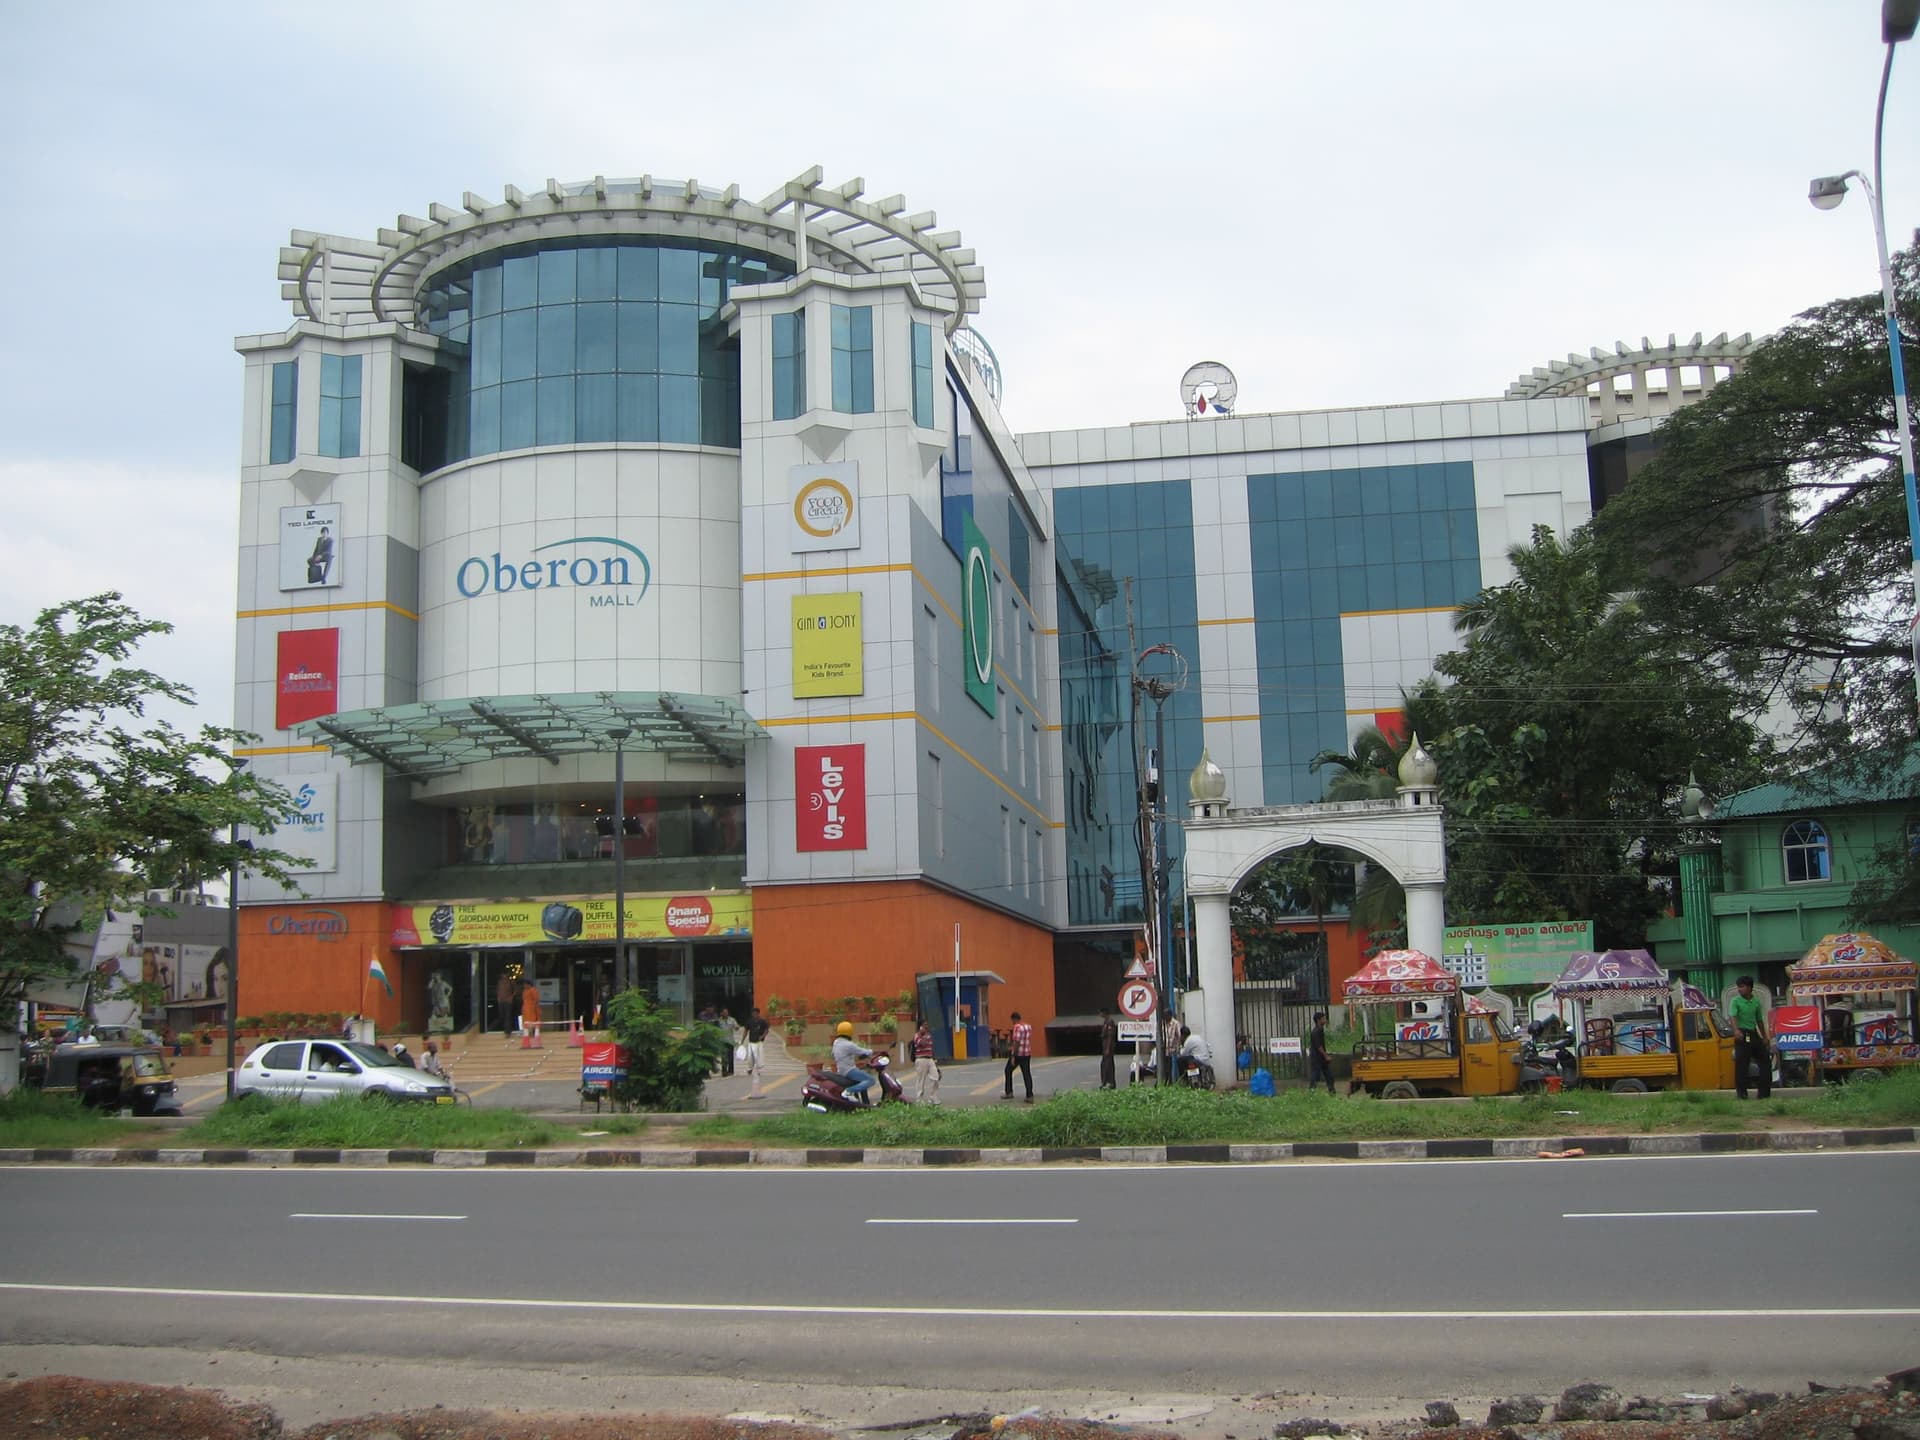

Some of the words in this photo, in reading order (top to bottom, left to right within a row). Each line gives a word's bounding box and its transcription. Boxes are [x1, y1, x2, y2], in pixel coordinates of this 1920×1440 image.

[808, 496, 843, 507] FOOD
[808, 506, 843, 517] CIRCLE
[457, 552, 632, 598] Oberon
[590, 595, 634, 607] MALL
[288, 672, 322, 680] Reliance
[458, 905, 476, 913] FREE
[586, 902, 605, 910] FREE
[585, 912, 615, 920] DUFFEL
[668, 907, 701, 916] Onam
[458, 914, 500, 922] GIORDANO
[502, 914, 529, 922] WATCH
[668, 915, 710, 927] Special
[1779, 1034, 1820, 1043] AIRCEL
[583, 1066, 613, 1074] AIRCEL
